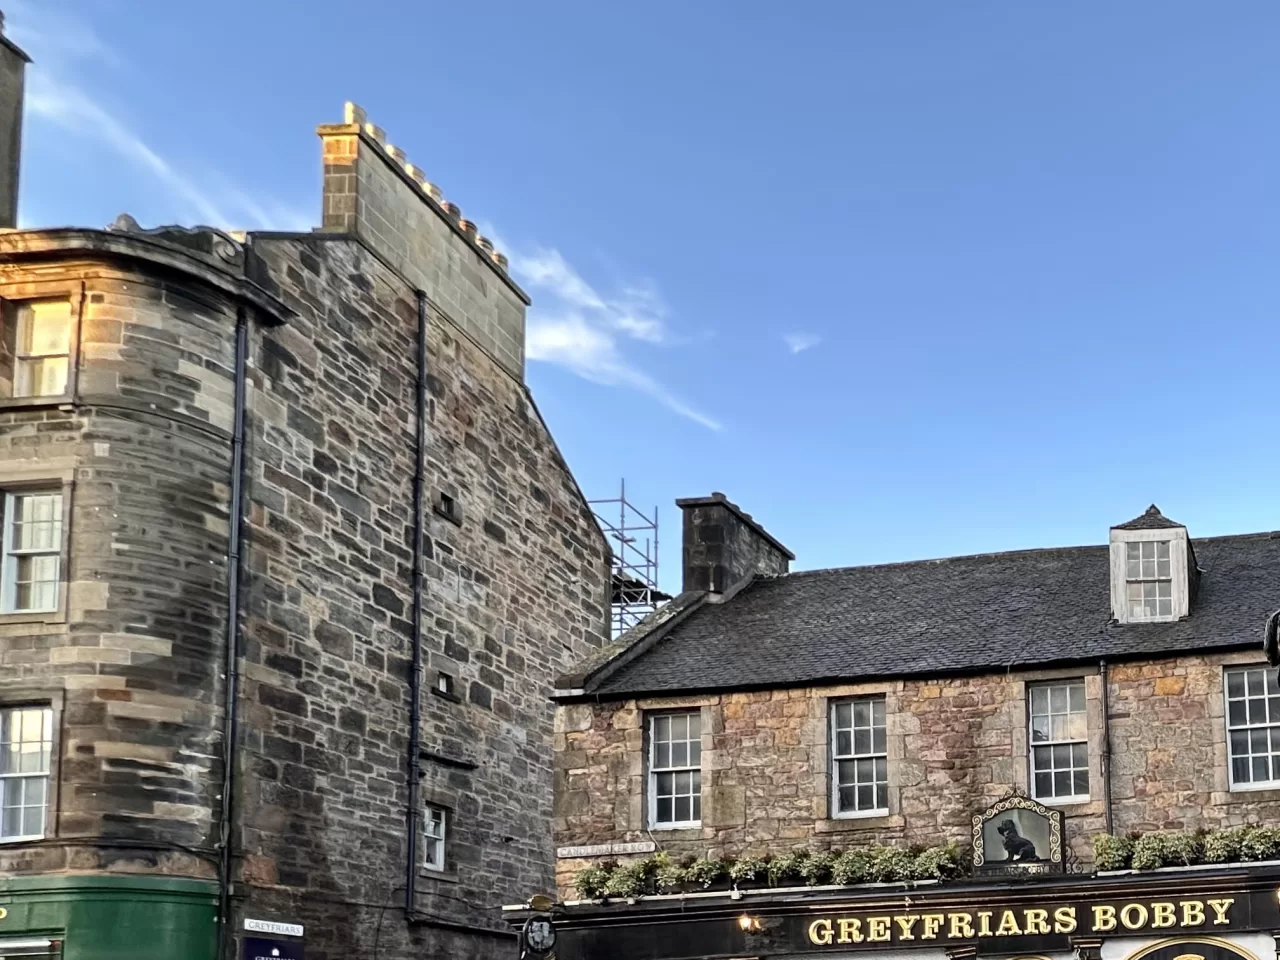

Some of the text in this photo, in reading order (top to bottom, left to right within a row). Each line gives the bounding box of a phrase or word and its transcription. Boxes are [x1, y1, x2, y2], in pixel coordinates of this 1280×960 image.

[248, 921, 300, 934] GREYFRIARS
[808, 898, 1235, 946] GREYFRIARS BOBBY
